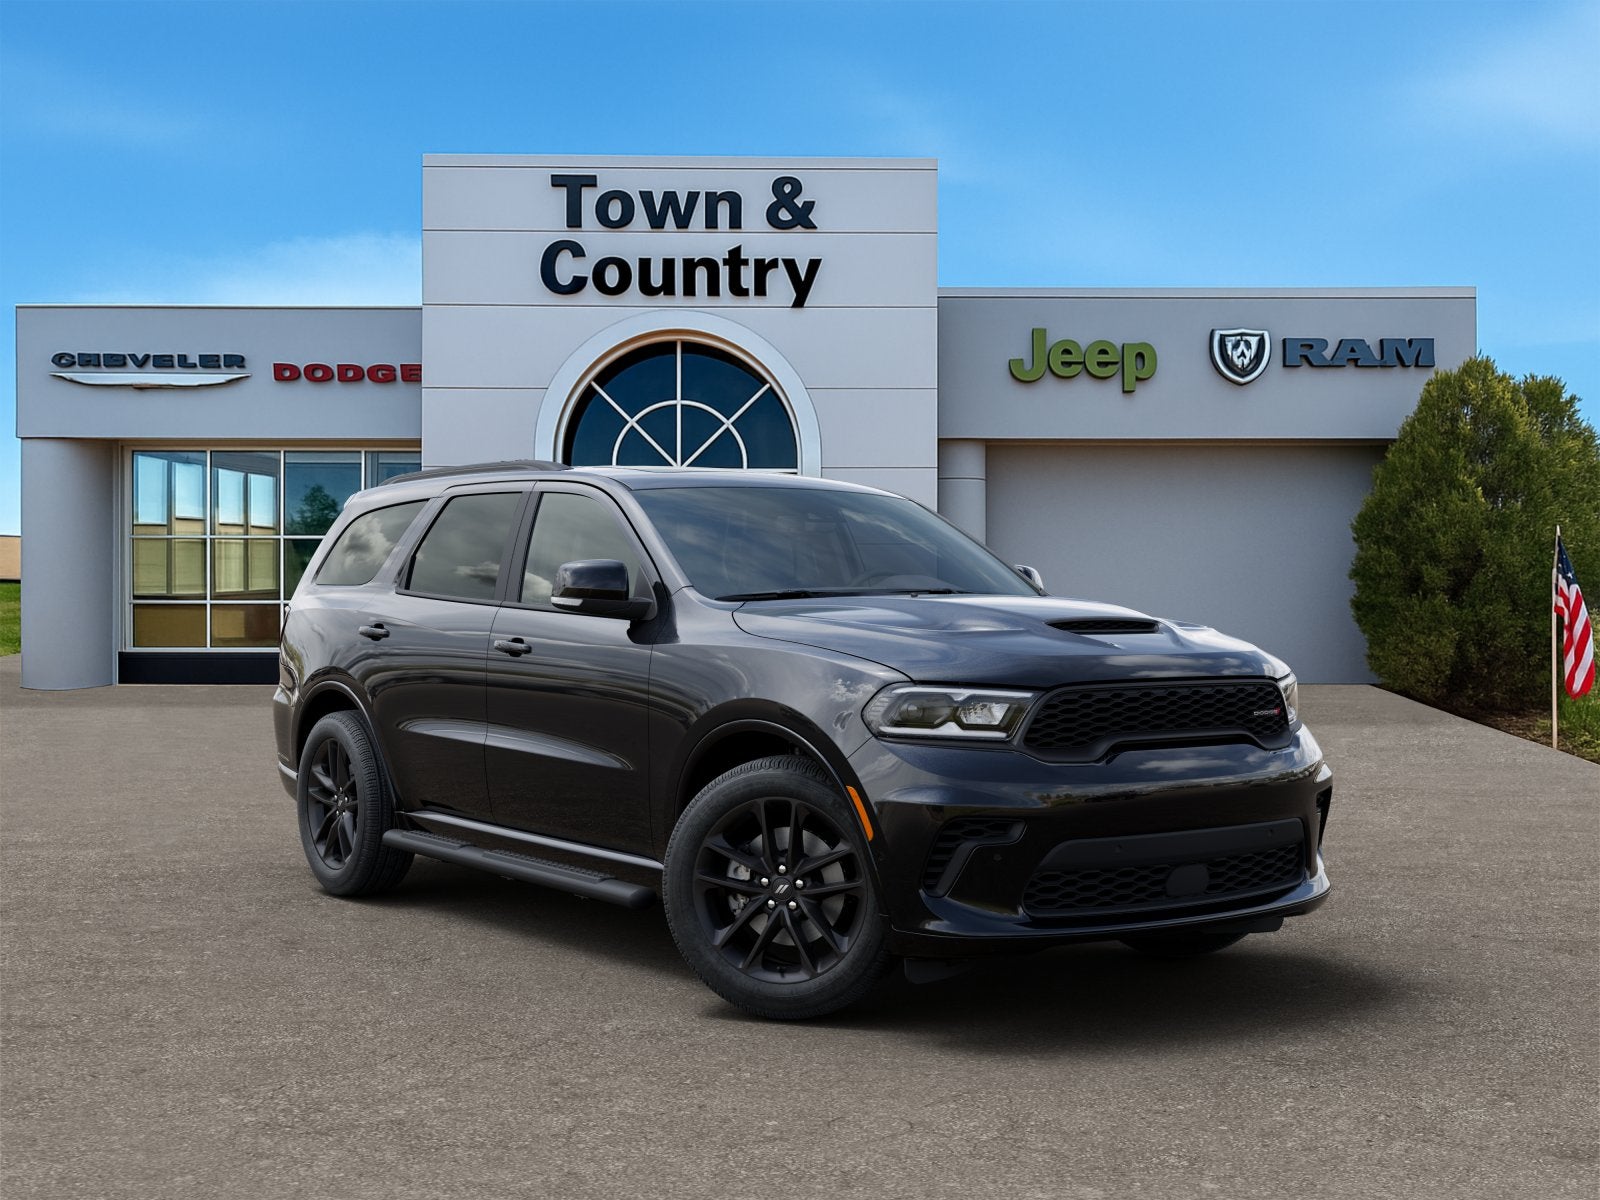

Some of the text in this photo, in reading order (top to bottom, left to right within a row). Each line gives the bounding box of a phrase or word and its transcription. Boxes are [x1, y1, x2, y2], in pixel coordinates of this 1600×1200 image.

[551, 174, 818, 230] Town &
[540, 239, 822, 308] Country
[273, 363, 422, 383] DODGE
[1008, 327, 1158, 393] Jeep
[1282, 337, 1436, 368] RAM
